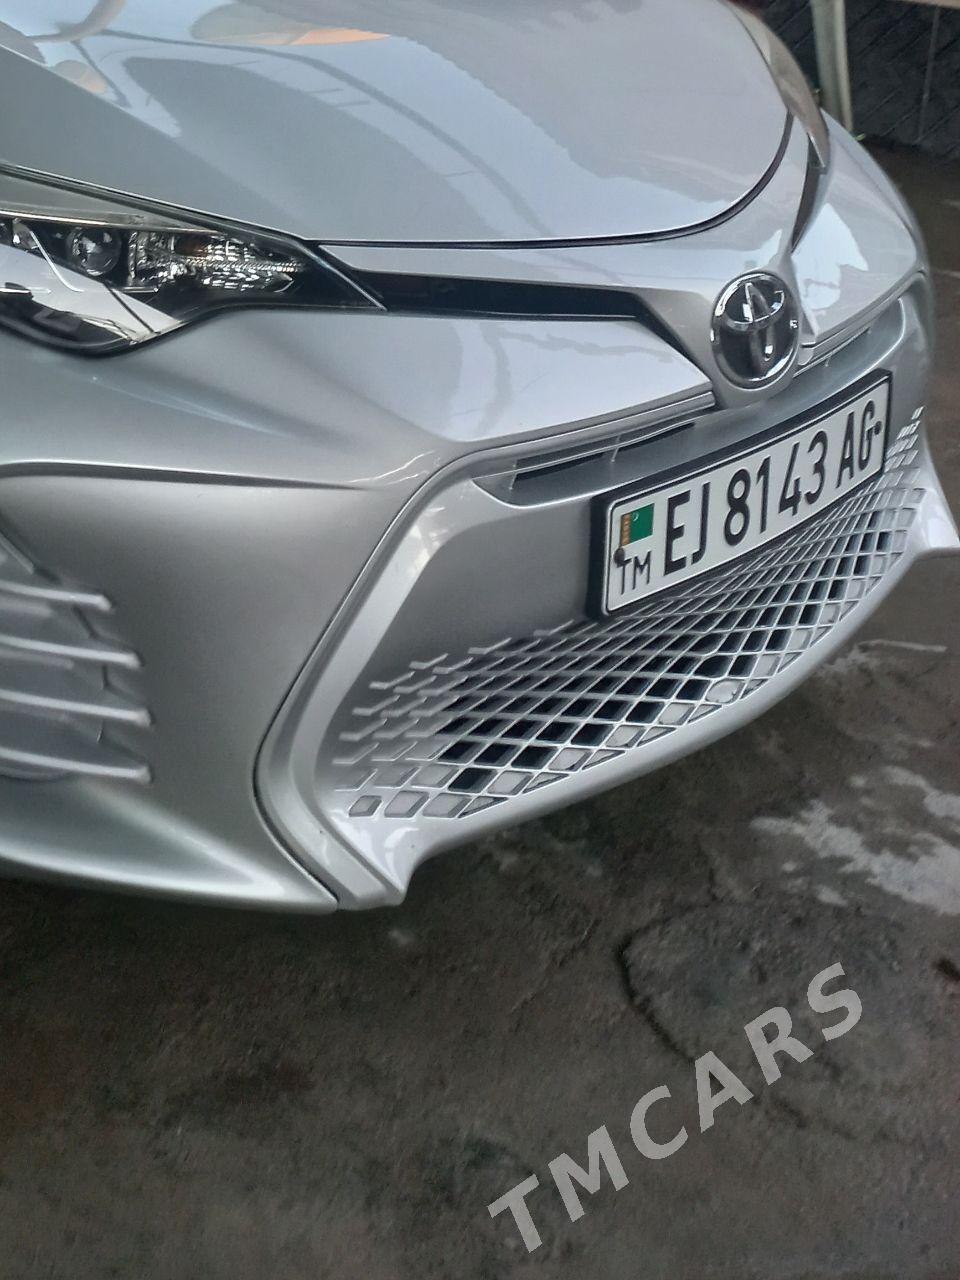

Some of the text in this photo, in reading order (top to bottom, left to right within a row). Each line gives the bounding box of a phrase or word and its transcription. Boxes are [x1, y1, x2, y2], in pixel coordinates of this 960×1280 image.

[664, 400, 876, 576] EJ 8143 AG
[616, 551, 652, 596] TM
